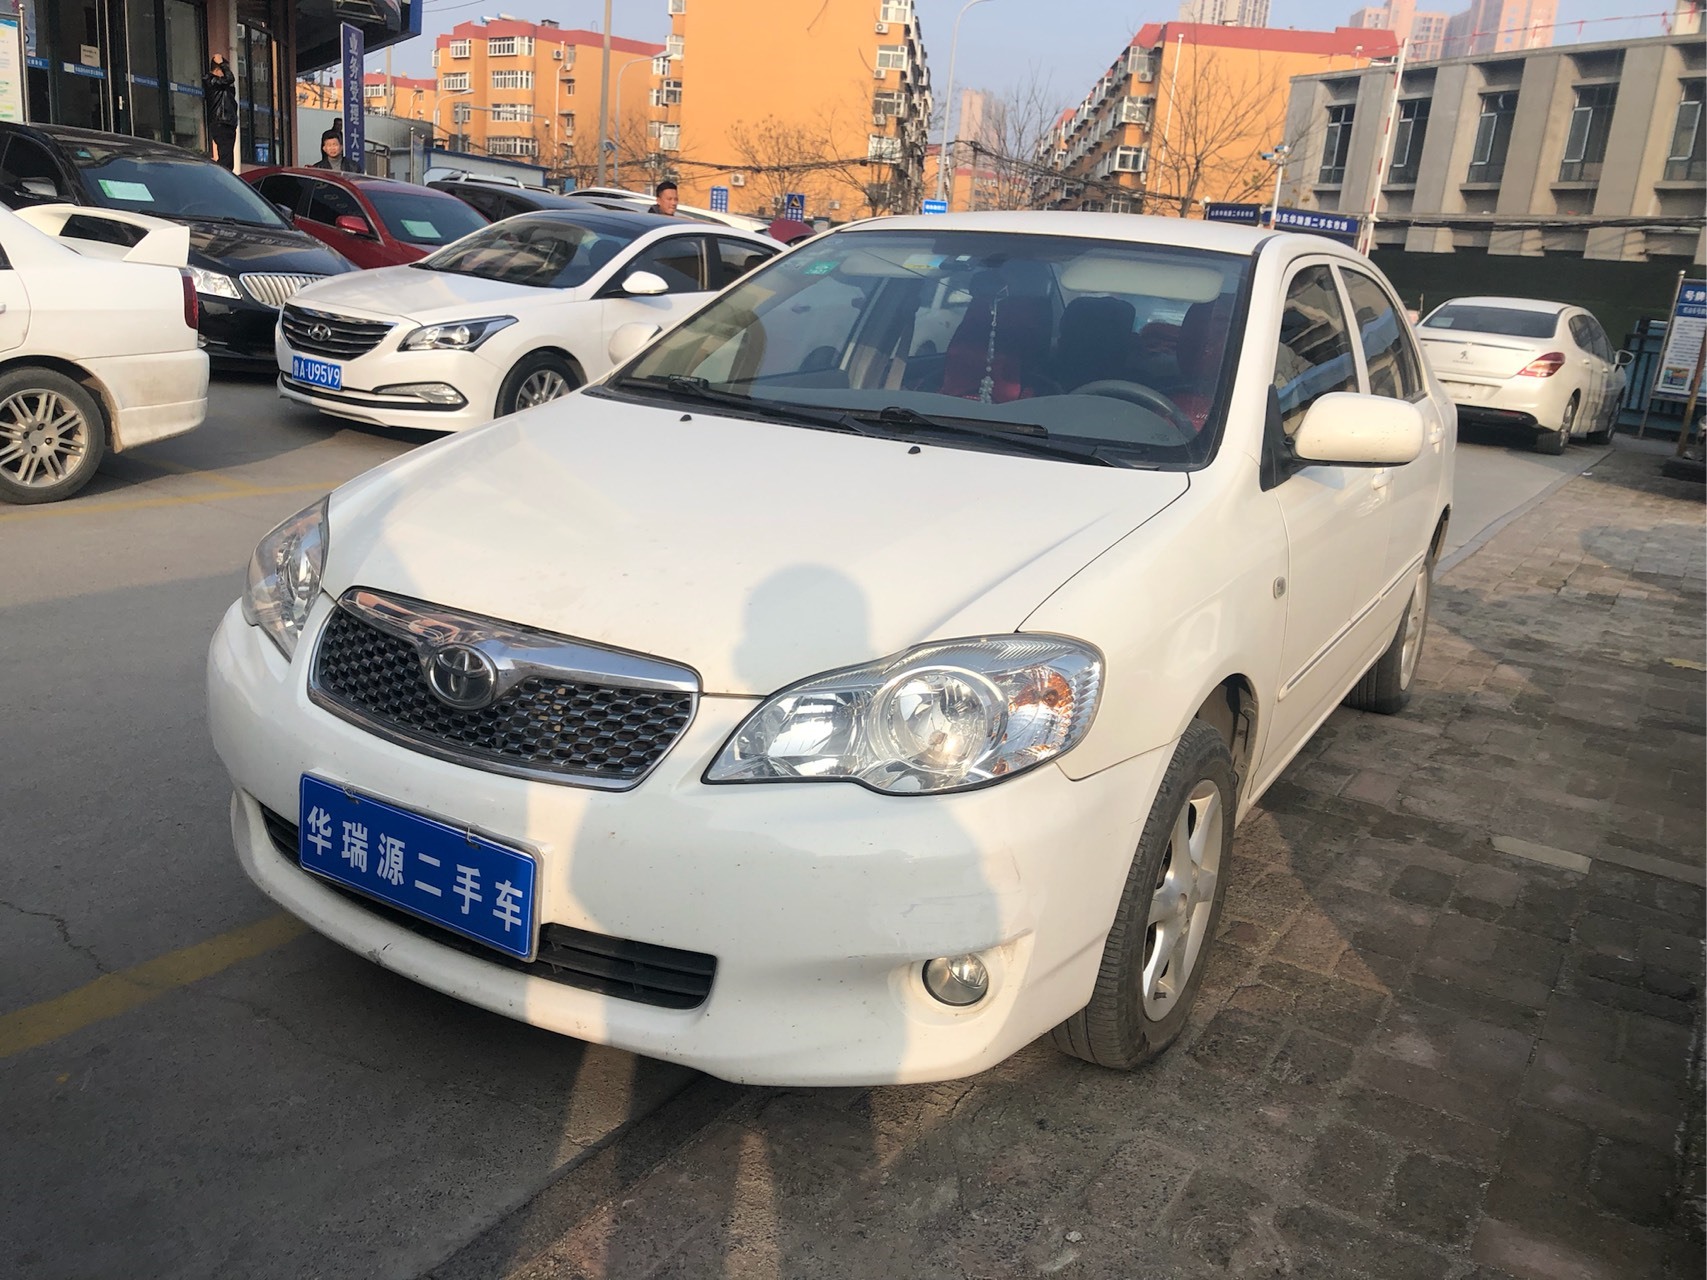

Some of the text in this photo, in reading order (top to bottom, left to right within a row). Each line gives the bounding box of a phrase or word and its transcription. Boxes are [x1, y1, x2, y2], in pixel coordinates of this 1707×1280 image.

[306, 804, 525, 933] 华瑞源二手车
